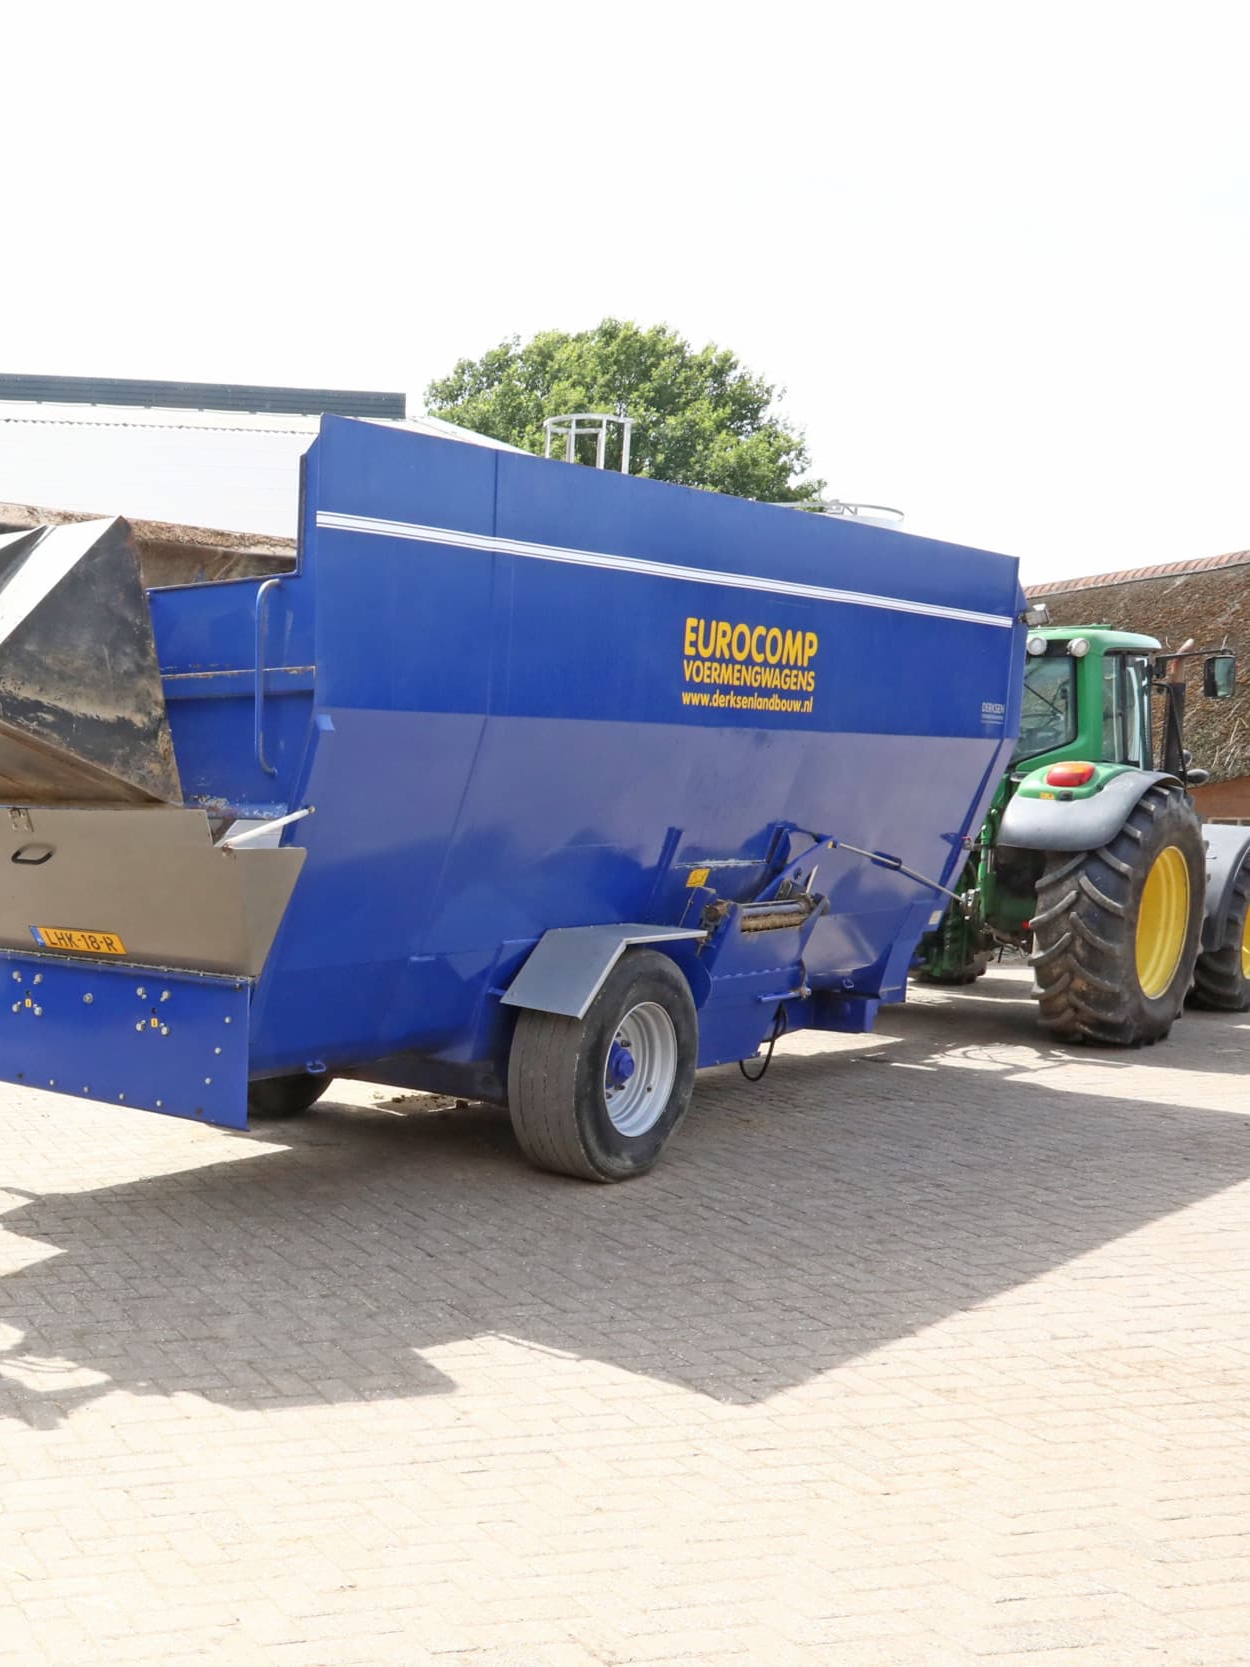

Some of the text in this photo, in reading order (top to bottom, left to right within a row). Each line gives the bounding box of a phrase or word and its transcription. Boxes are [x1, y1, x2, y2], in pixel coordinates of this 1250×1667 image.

[684, 617, 818, 667] EUROCOMP
[683, 659, 815, 692] VOERMENGWAGENS
[682, 689, 814, 713] www.derksenlandbouw.nl
[44, 930, 119, 952] LHK-18-R
